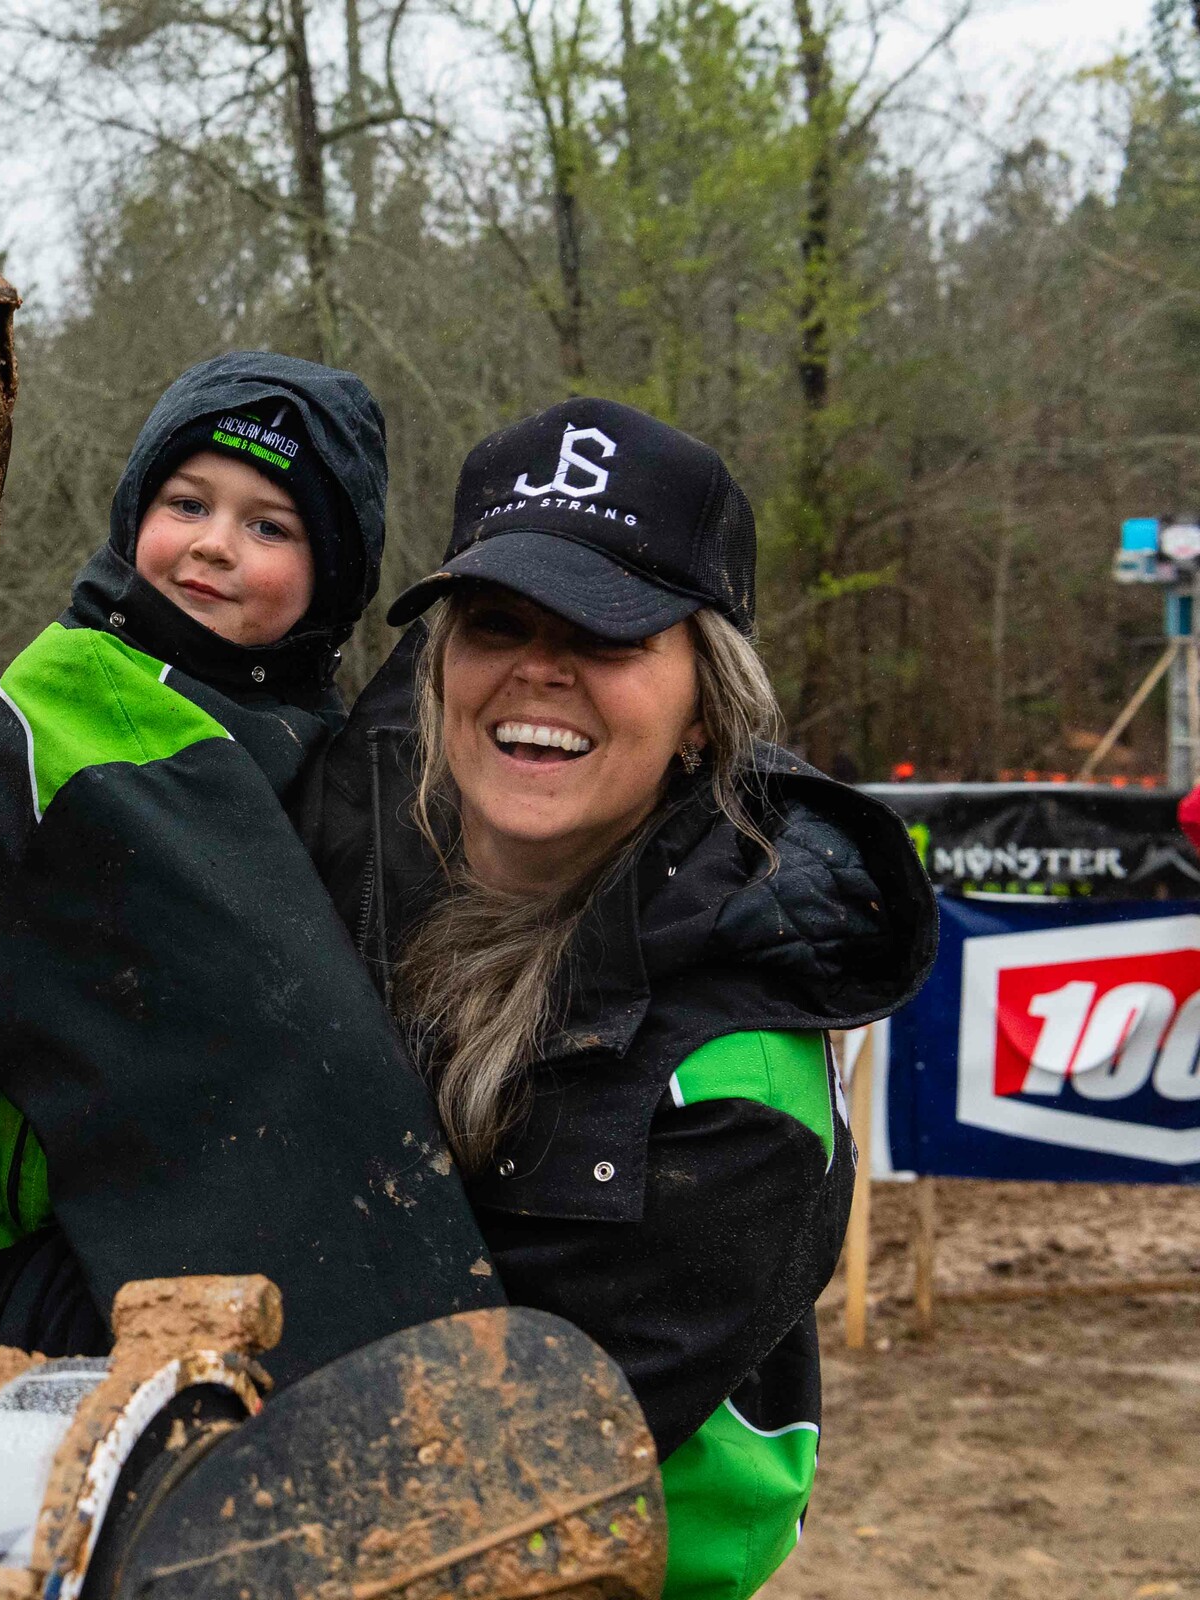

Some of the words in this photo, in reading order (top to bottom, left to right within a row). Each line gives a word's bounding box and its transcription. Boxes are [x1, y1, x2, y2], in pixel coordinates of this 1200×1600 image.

[217, 416, 262, 440] LACHLAN
[260, 429, 299, 457] MAYLED
[540, 497, 638, 527] STRANG
[933, 842, 1128, 880] MONSTER
